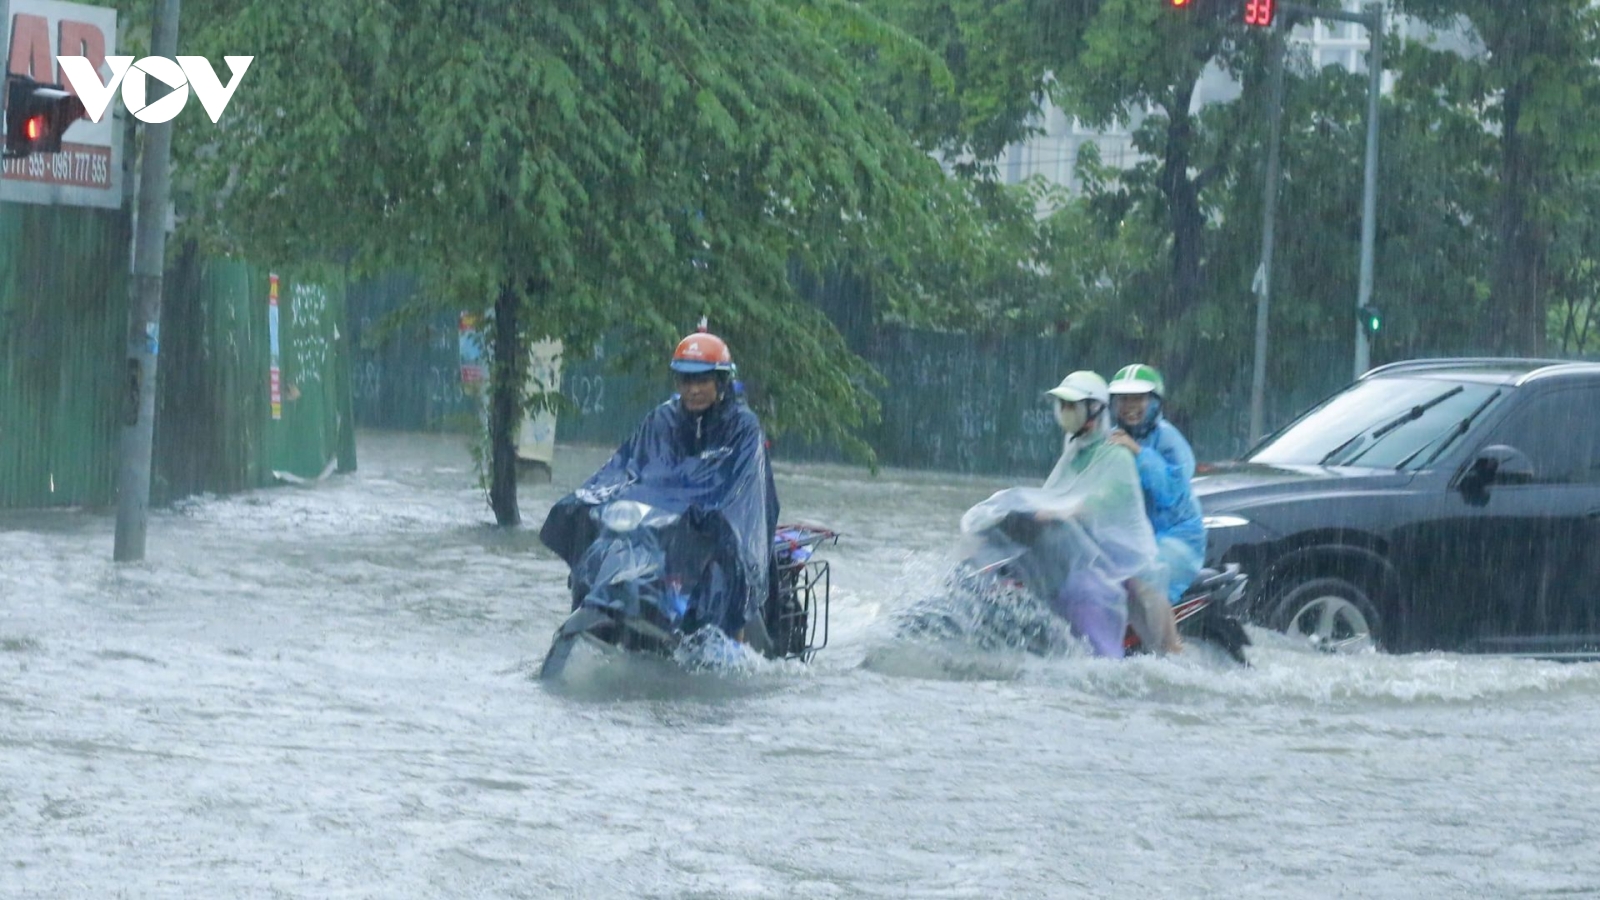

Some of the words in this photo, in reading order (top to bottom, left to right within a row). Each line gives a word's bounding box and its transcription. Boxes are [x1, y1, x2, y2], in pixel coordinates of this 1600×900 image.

[52, 151, 72, 179] 0961
[75, 152, 90, 180] 777
[91, 153, 107, 183] 555
